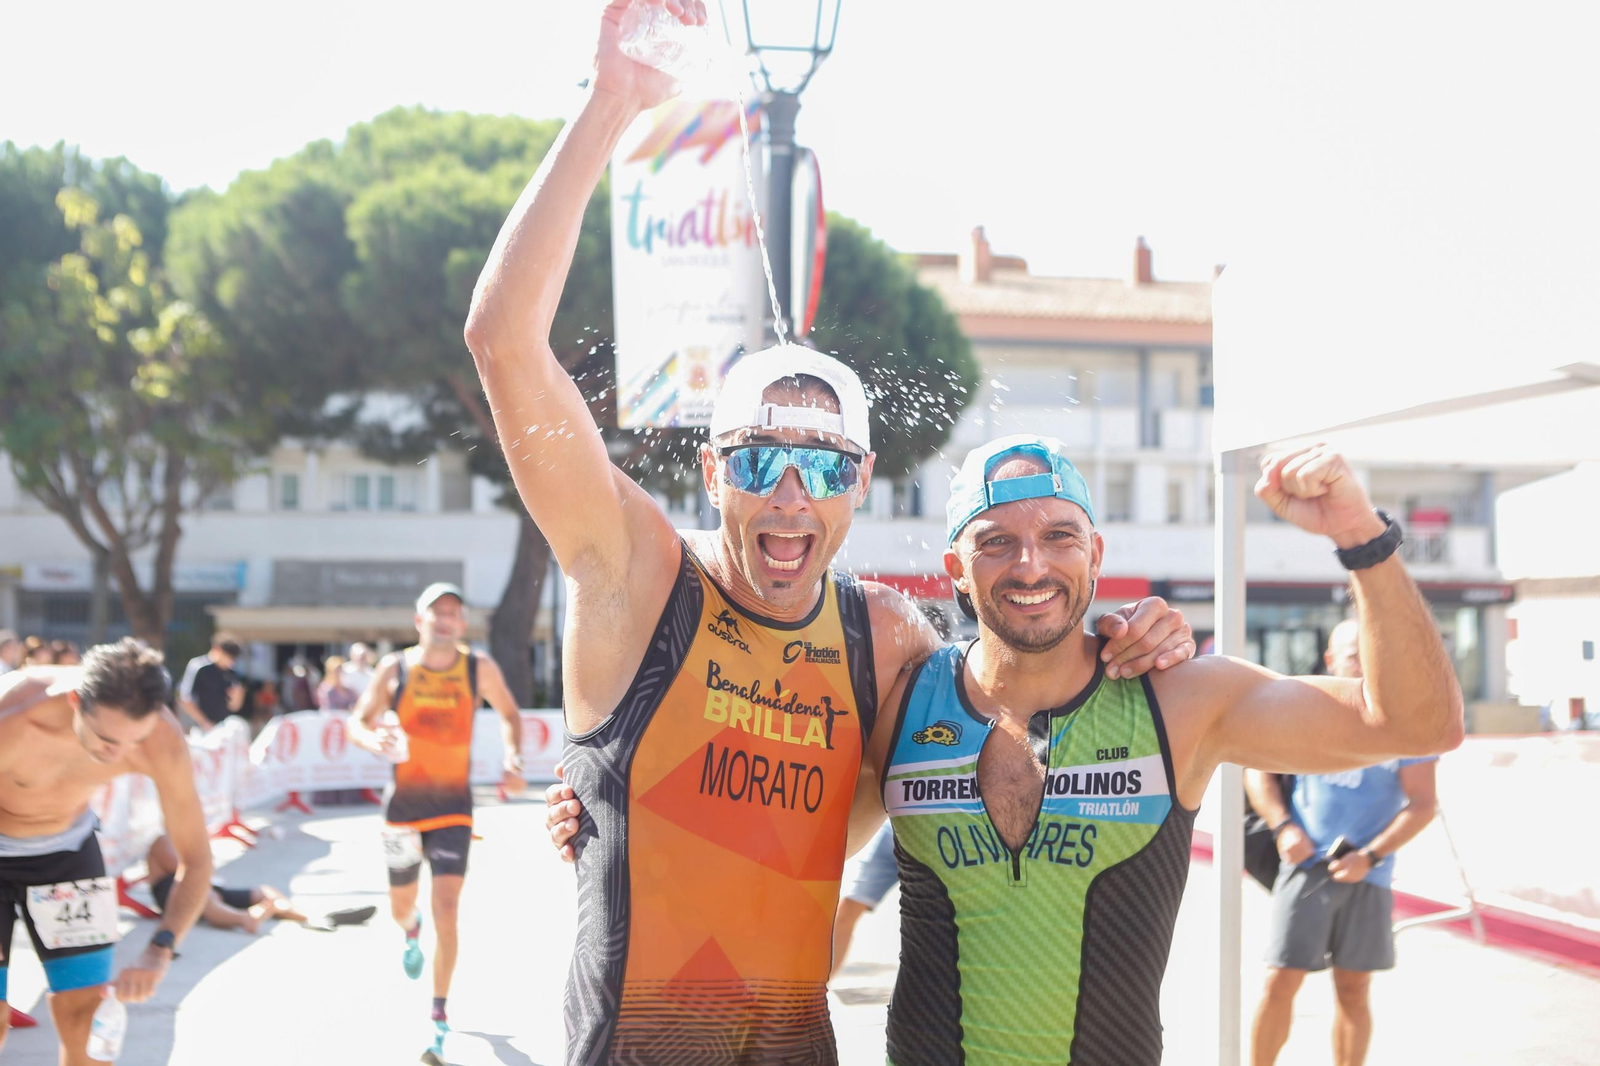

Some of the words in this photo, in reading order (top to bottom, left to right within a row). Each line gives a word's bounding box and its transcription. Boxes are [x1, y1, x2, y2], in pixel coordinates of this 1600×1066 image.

[804, 646, 840, 660] Triatlón
[703, 688, 827, 749] BRILLA
[1096, 746, 1129, 762] CLUB
[699, 742, 824, 814] MORATO
[1078, 799, 1140, 816] TRIATLÓN
[54, 900, 93, 926] 44
